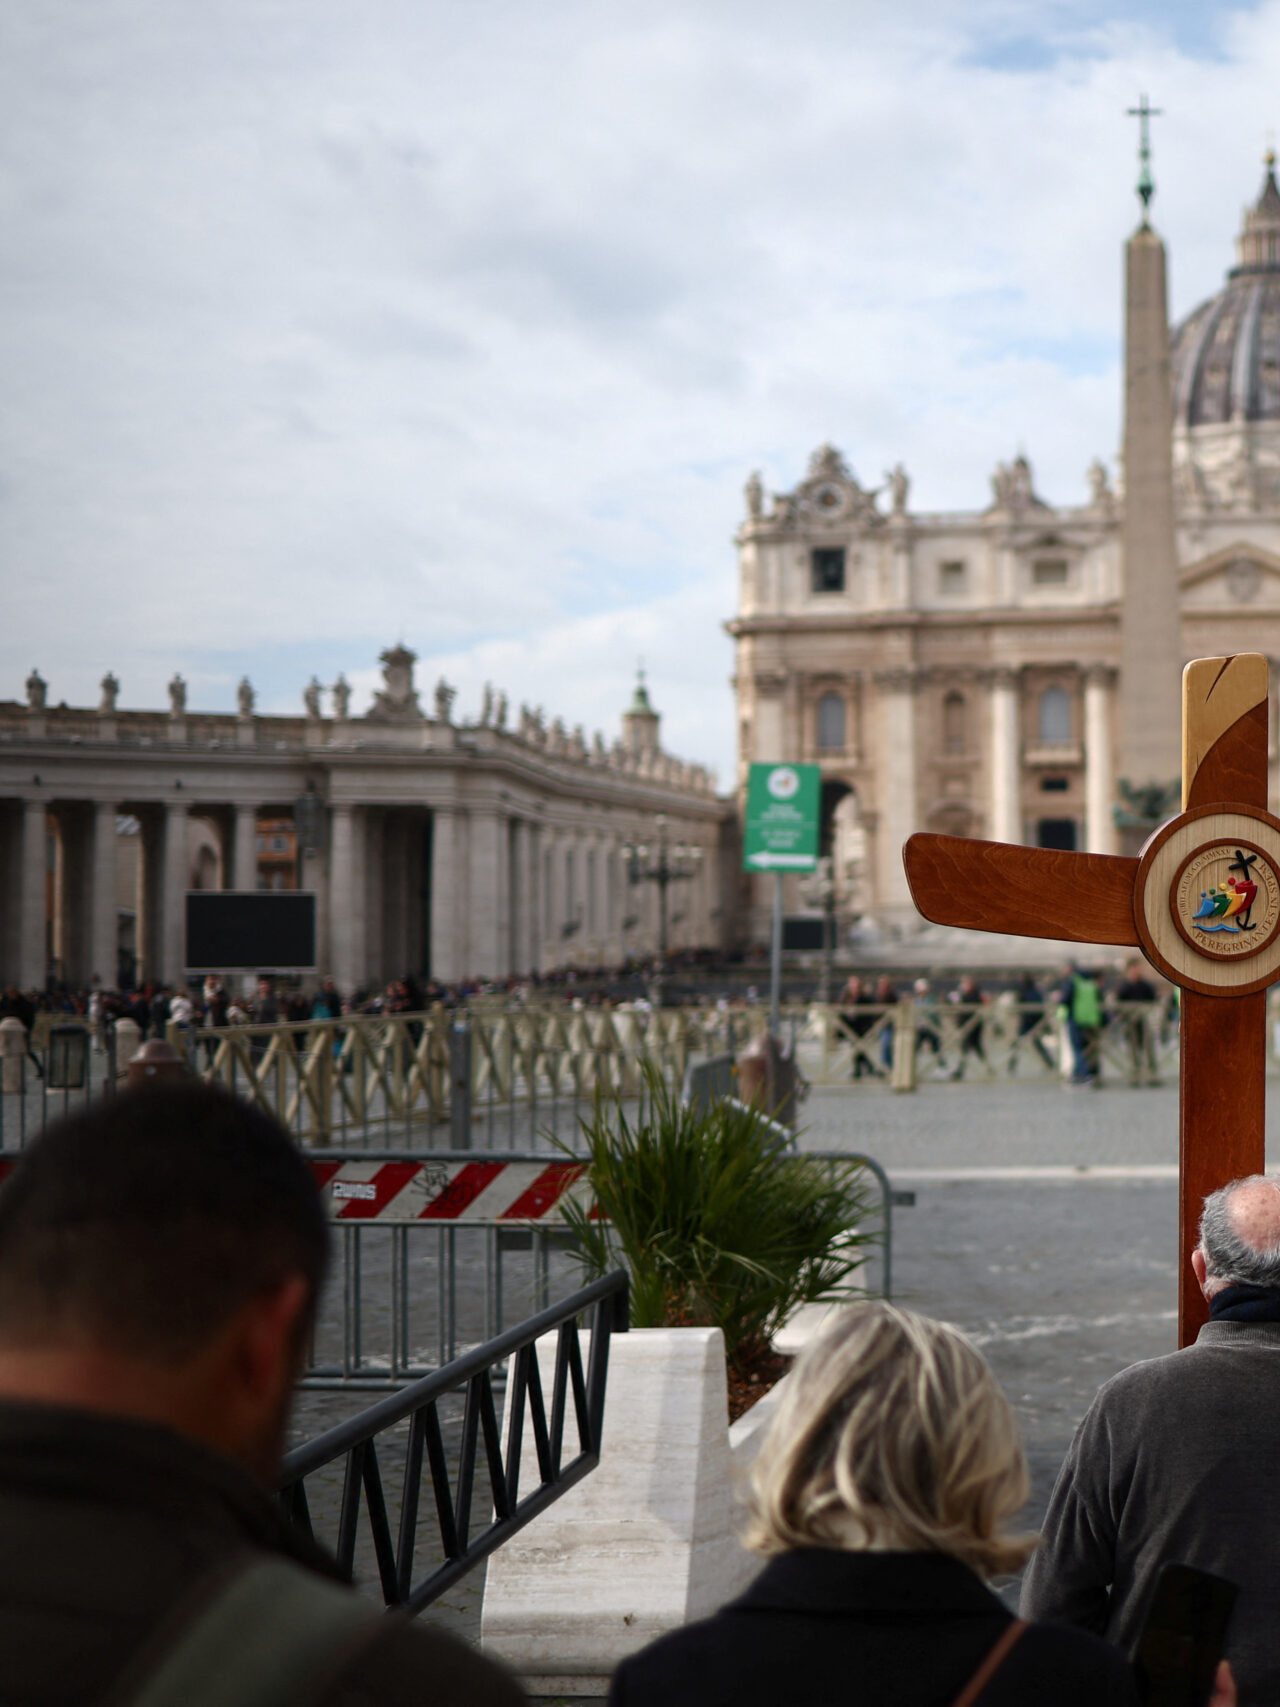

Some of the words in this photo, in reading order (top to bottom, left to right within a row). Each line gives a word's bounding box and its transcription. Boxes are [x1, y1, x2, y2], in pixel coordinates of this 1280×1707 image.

[1258, 863, 1277, 896] SPEM
[1270, 897, 1278, 910] IN
[1194, 912, 1275, 952] PEREGRINANTES
